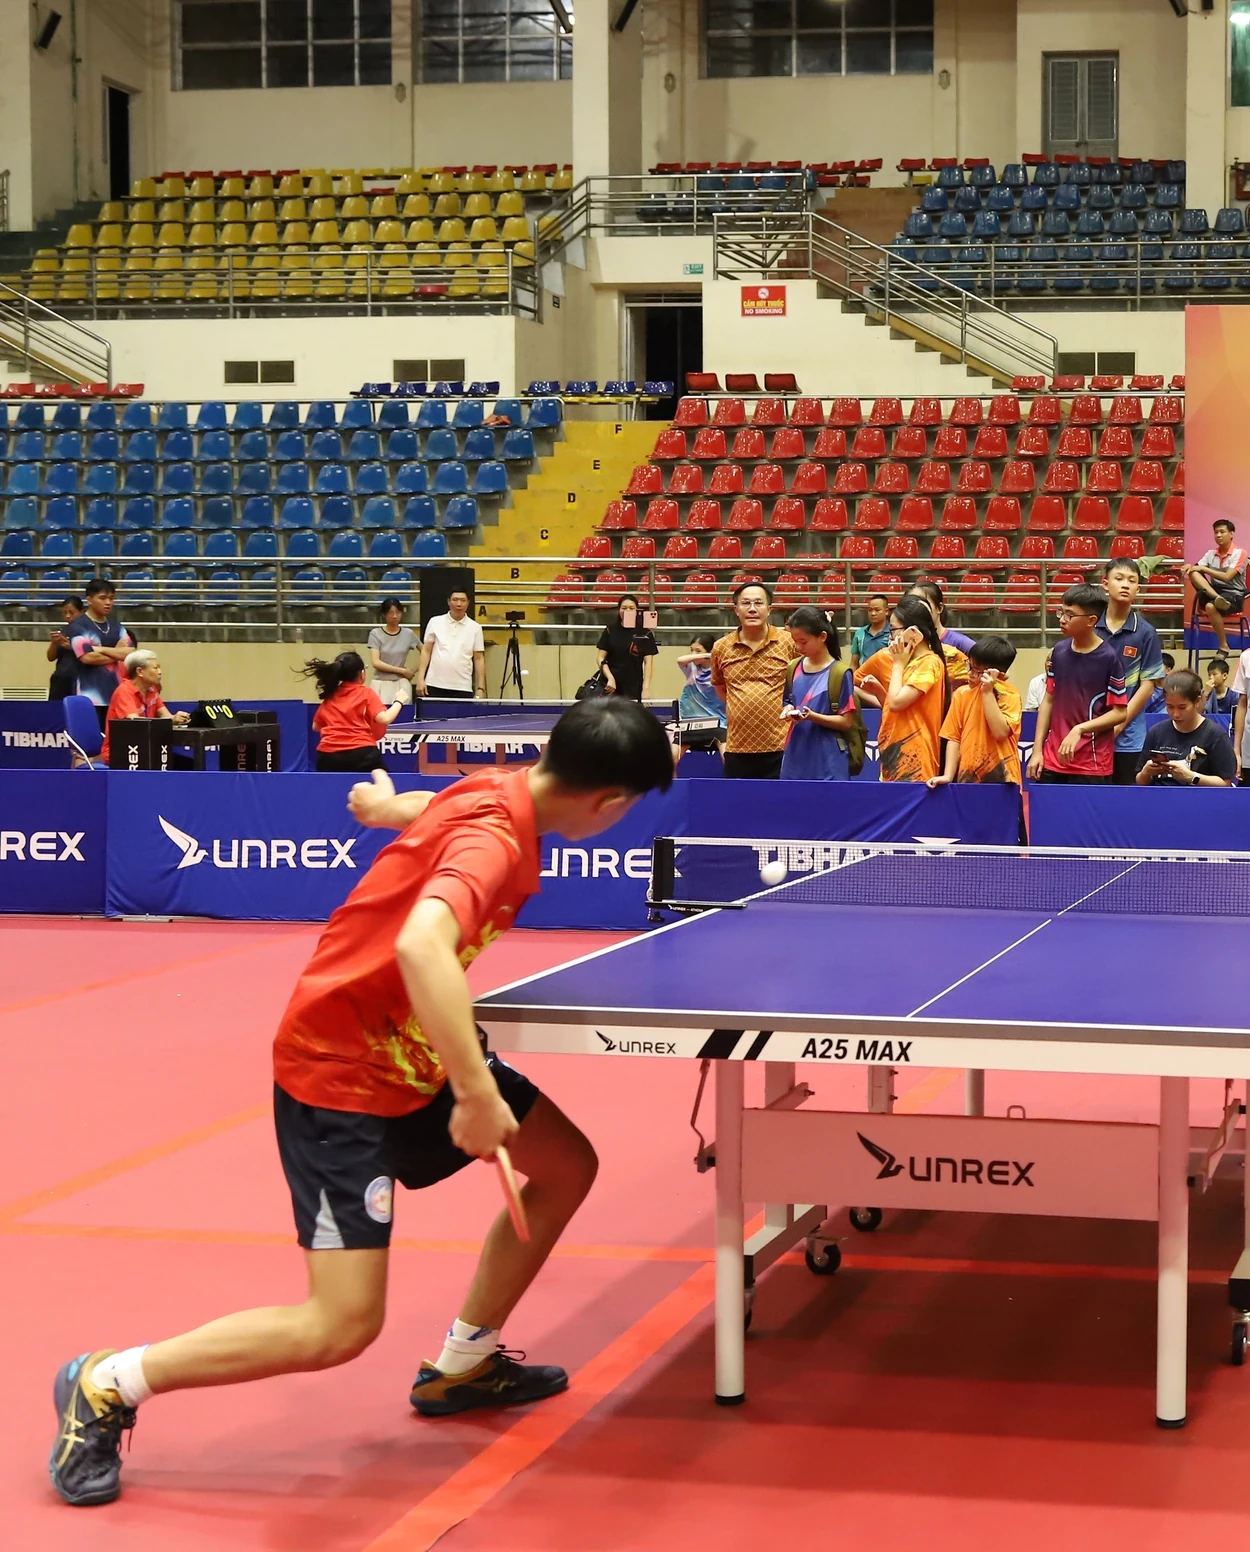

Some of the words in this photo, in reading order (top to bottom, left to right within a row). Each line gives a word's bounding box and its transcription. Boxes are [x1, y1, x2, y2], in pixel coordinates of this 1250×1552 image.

[615, 424, 622, 434] F
[593, 460, 600, 470] E
[568, 492, 576, 503] D
[540, 529, 548, 540] C
[510, 568, 520, 578] B
[478, 606, 488, 616] A
[2, 731, 70, 748] TIBHAR
[128, 745, 138, 770] REX
[0, 831, 85, 862] REX
[213, 839, 356, 868] UNREX
[619, 1041, 676, 1054] UNREX
[802, 1038, 848, 1060] A25
[856, 1040, 913, 1062] MAX
[908, 1158, 1035, 1187] UNREX
